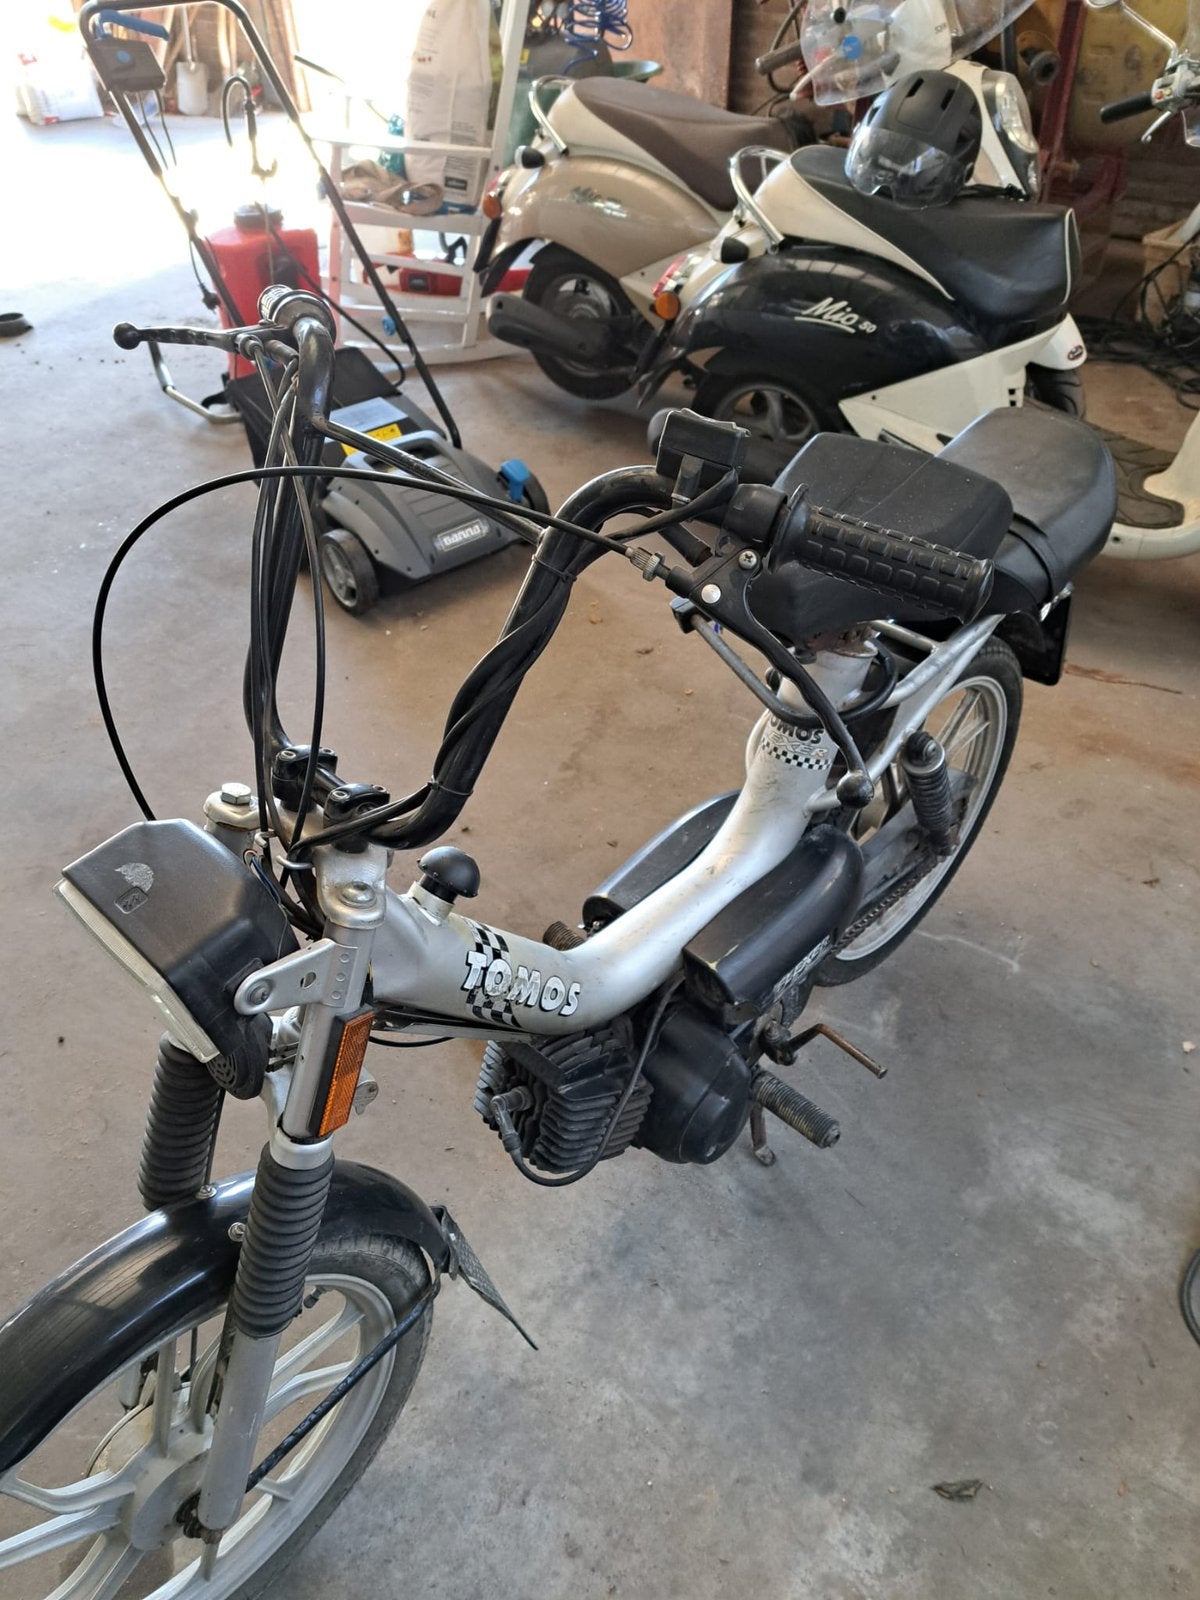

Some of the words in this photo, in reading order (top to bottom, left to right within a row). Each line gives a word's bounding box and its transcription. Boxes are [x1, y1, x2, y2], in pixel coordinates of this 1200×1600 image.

[801, 297, 859, 325] Mio
[858, 320, 877, 333] 50
[768, 731, 828, 758] EXER
[770, 715, 824, 744] OMOS
[461, 950, 581, 1017] TOMOS
